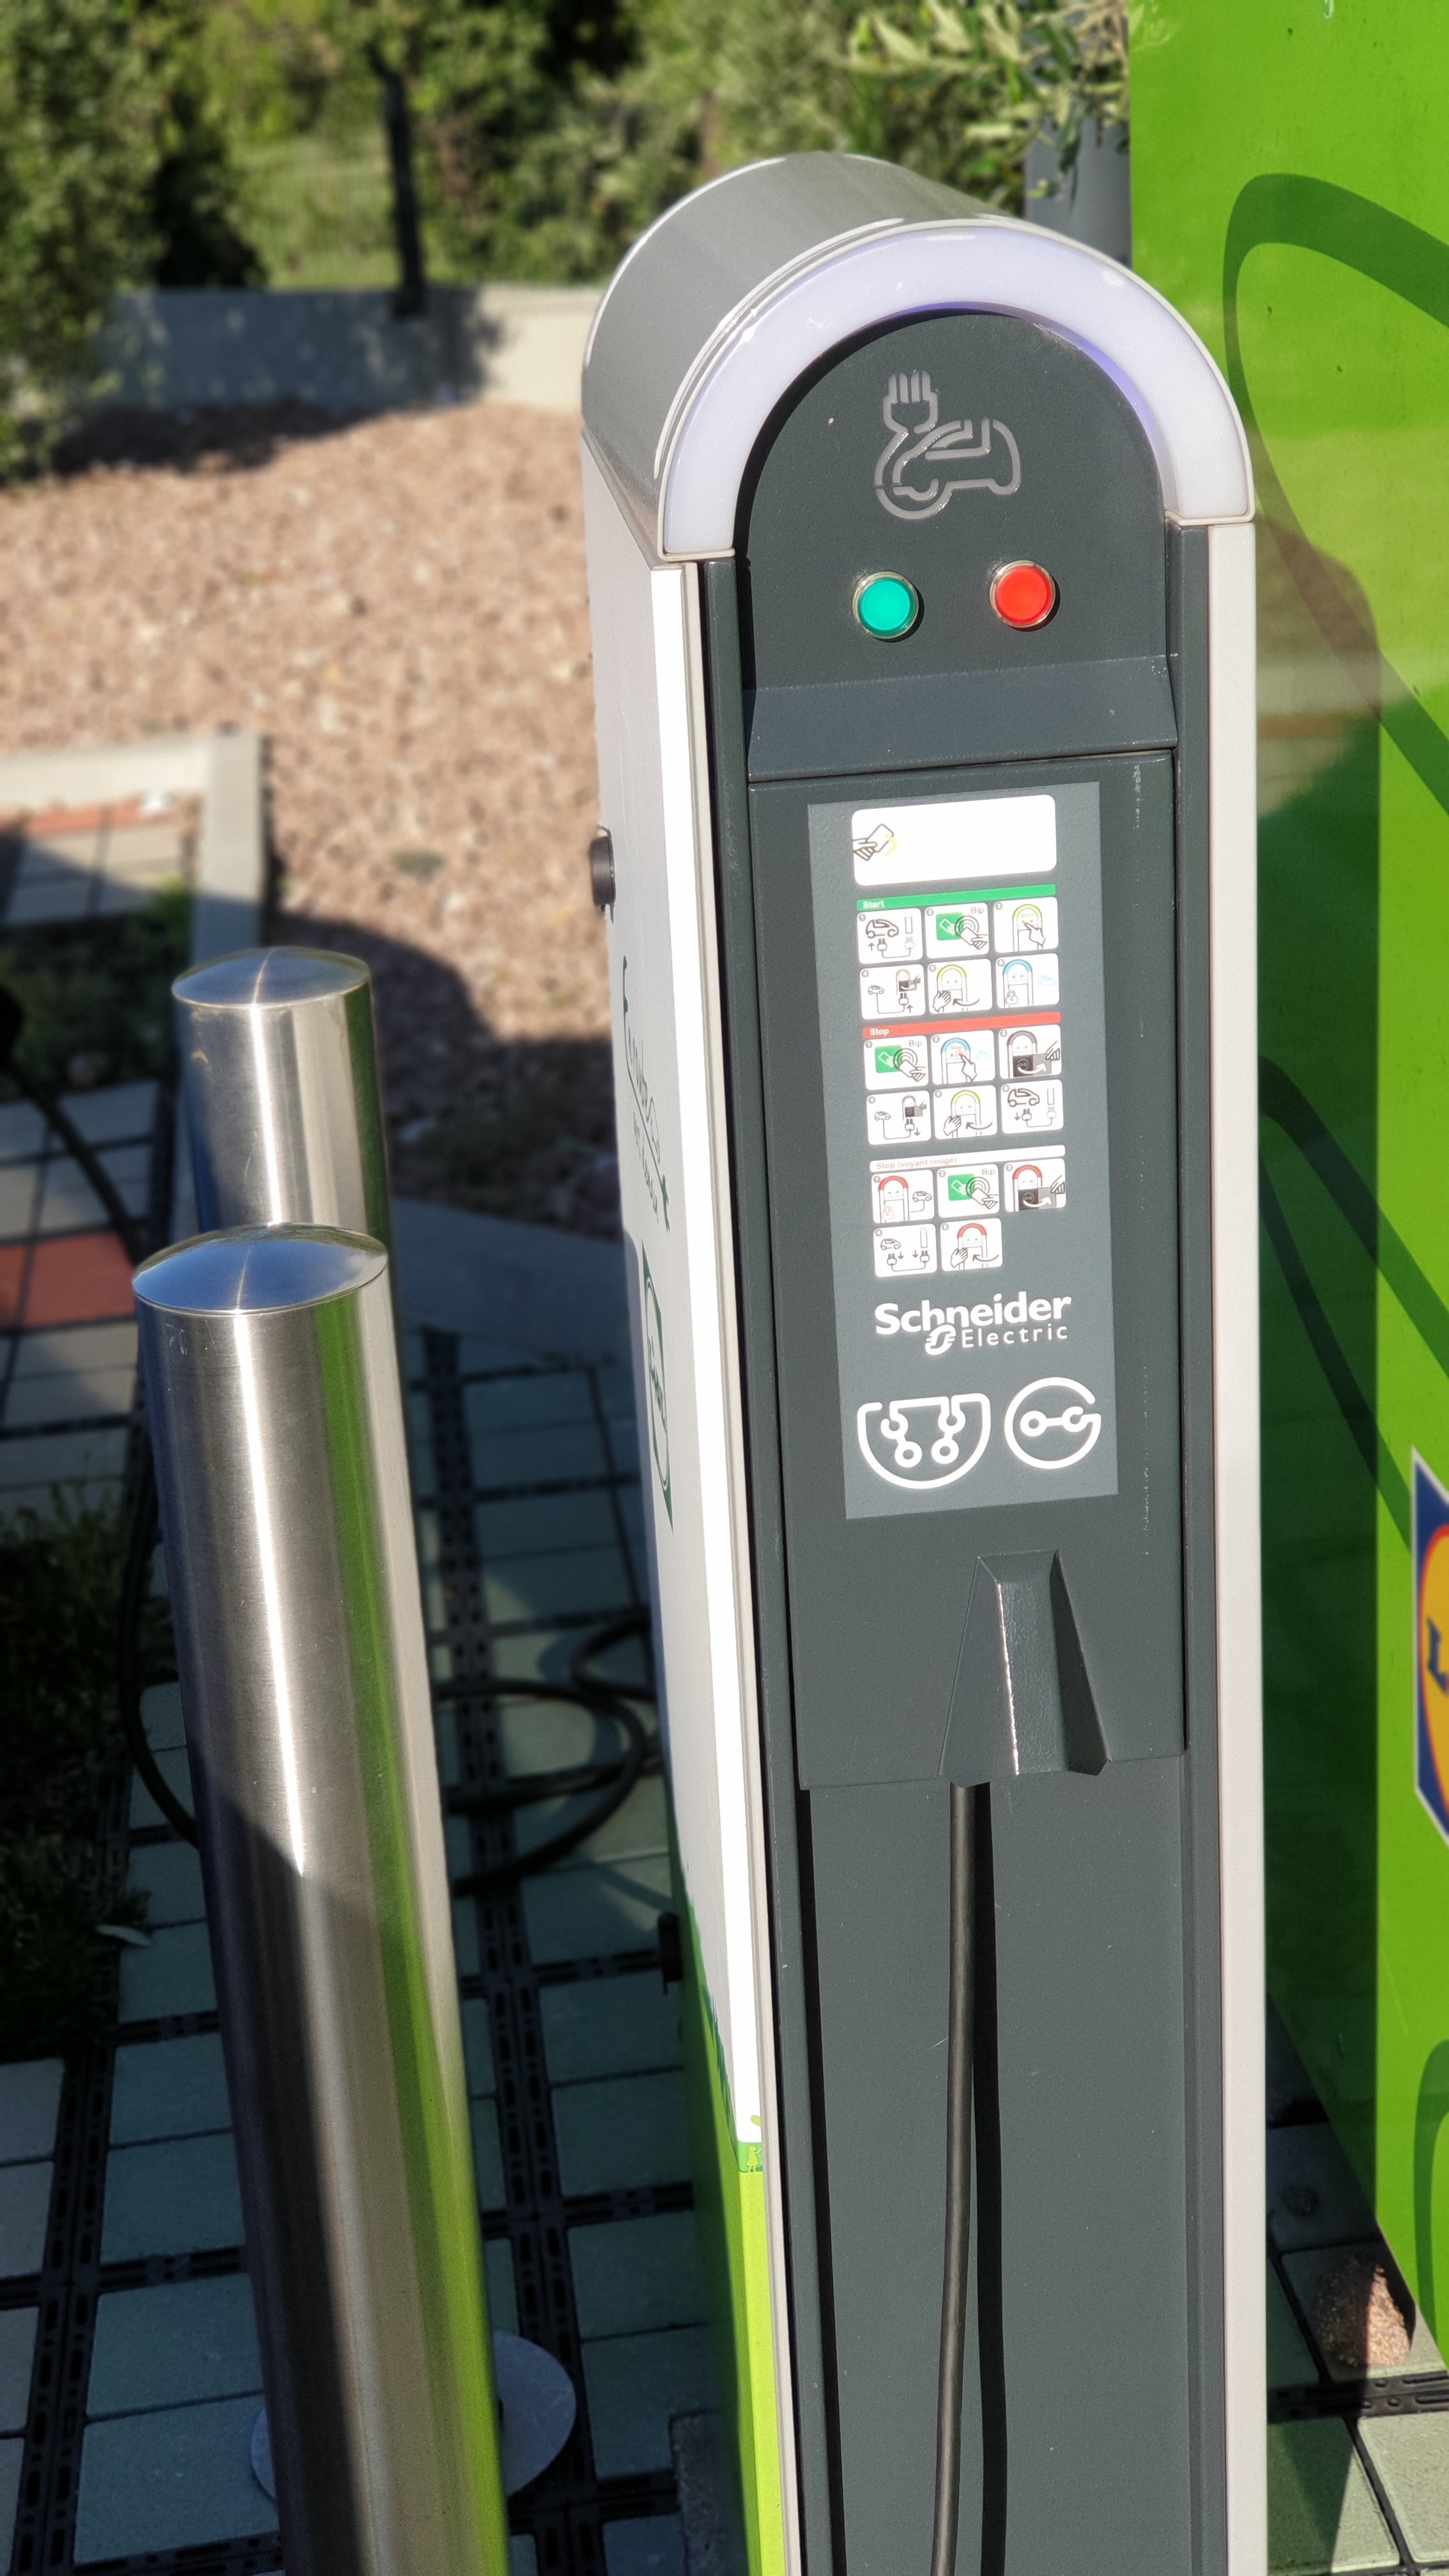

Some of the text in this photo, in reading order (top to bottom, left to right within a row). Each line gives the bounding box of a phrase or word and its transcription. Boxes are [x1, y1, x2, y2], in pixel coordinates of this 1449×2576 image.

[863, 900, 885, 908] Start
[970, 907, 985, 915] Bip
[870, 1028, 889, 1037] Stop
[898, 1159, 928, 1169] (voyant
[930, 1156, 957, 1165] rouge)
[875, 1291, 1072, 1335] Schneider
[962, 1322, 1068, 1348] Electric
